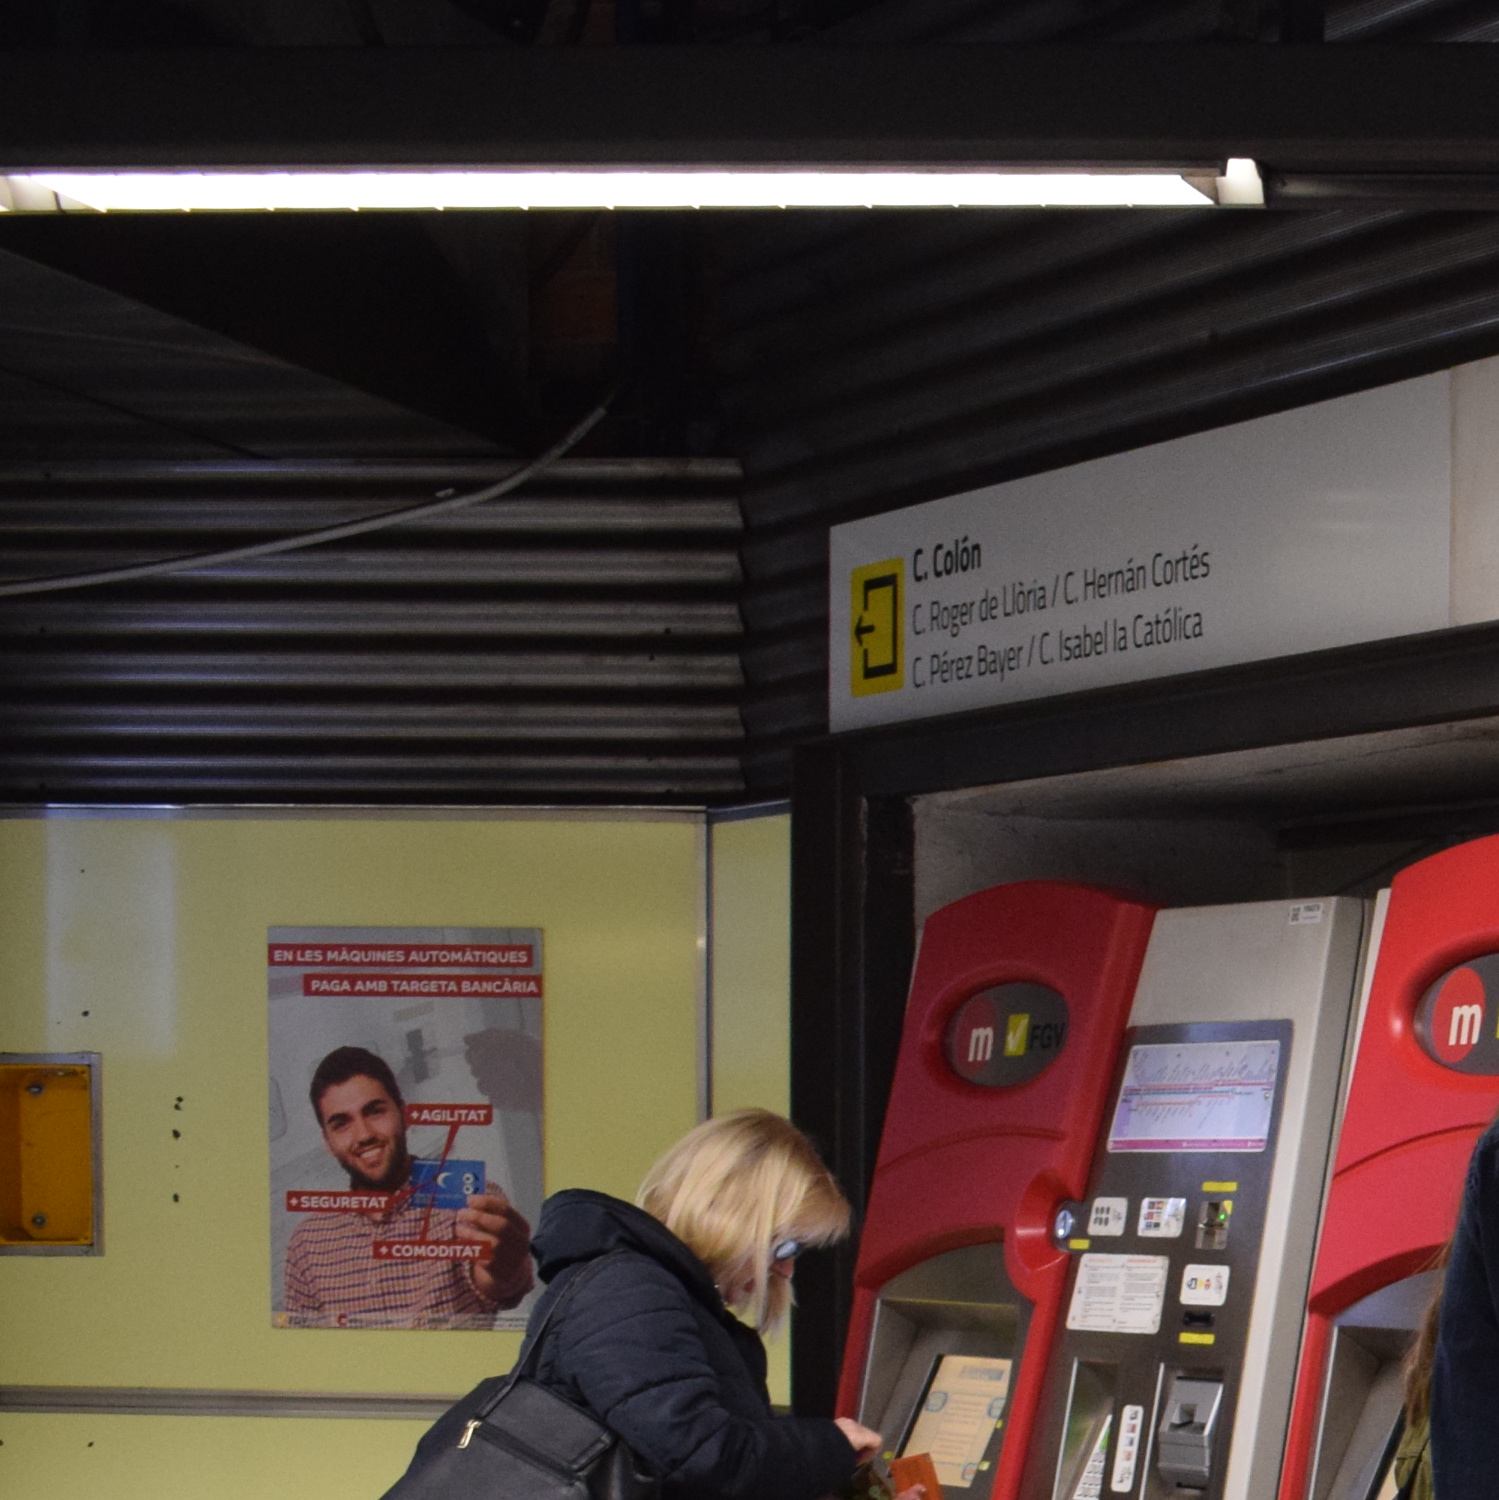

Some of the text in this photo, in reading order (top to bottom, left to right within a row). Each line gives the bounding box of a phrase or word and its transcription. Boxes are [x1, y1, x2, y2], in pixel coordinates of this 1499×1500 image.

[913, 537, 981, 581] C. Colón
[913, 606, 926, 635] C.
[930, 594, 974, 638] Roger
[979, 589, 998, 624] de
[1051, 575, 1060, 610] /
[1064, 571, 1079, 605] C.
[1084, 558, 1146, 600] Hernán
[1153, 544, 1210, 589] Cortés
[913, 607, 1203, 689] C. Pérez Bayer / C. Isabel la Católica
[274, 946, 528, 965] EN LES MÀQUINES AUTOMÀTIQUES
[311, 976, 537, 995] PAGA AMB TARGETA BANCÀRIA
[1030, 1022, 1065, 1051] FGV
[1448, 1004, 1482, 1046] m
